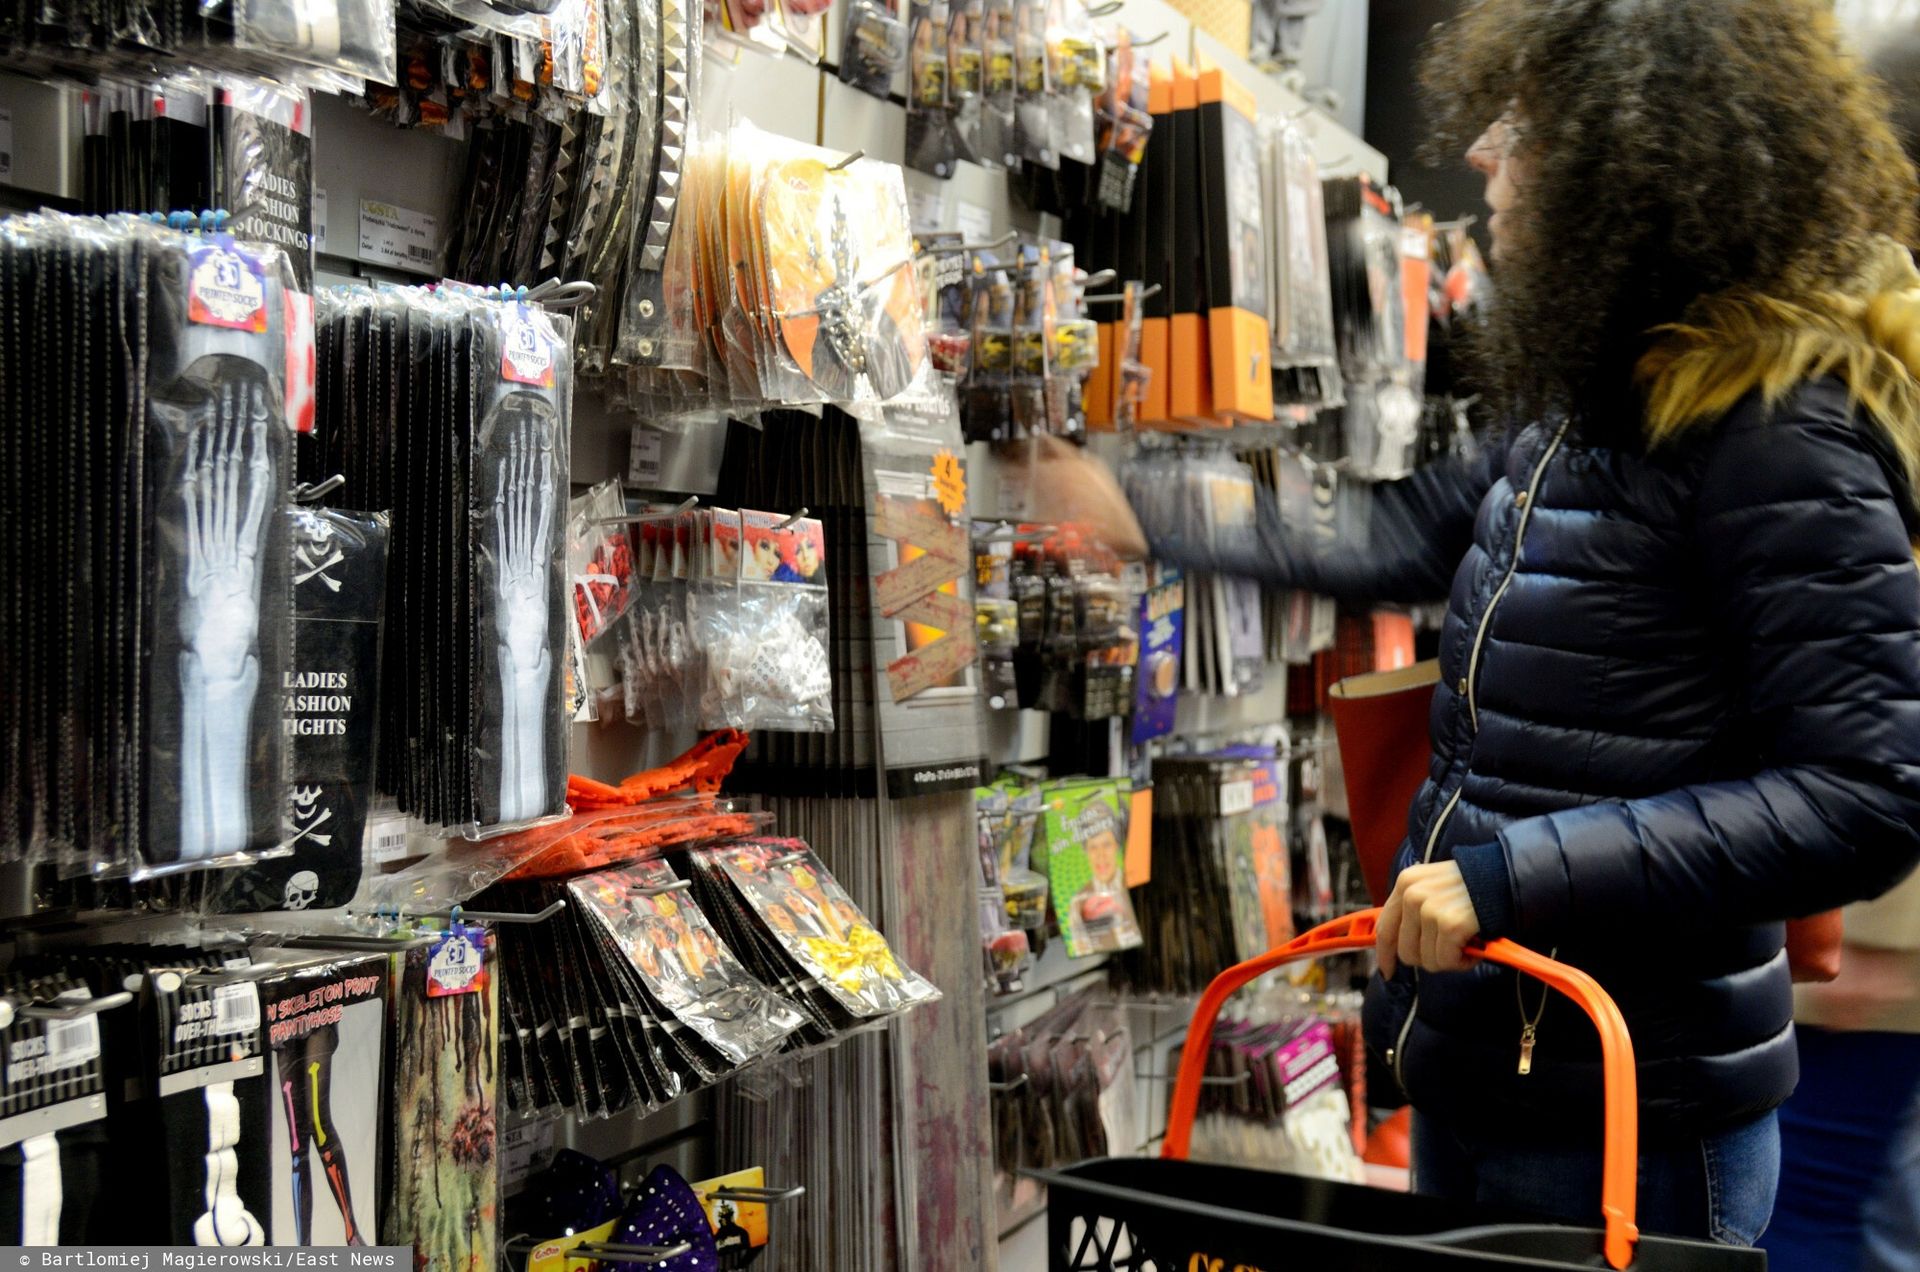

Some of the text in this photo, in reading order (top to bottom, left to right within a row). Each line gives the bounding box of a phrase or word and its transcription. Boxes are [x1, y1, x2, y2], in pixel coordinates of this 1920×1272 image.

[246, 192, 299, 223] FSHION
[214, 259, 240, 290] 3D
[283, 671, 347, 689] LADIES
[282, 718, 346, 736] TIGHTS
[446, 942, 466, 966] 3D
[279, 981, 343, 1019] SKELETON
[344, 976, 380, 998] PRINT
[180, 1000, 212, 1022] SOCKS
[174, 1018, 217, 1043] OVER-TH
[270, 1004, 344, 1045] PANTYHOSE
